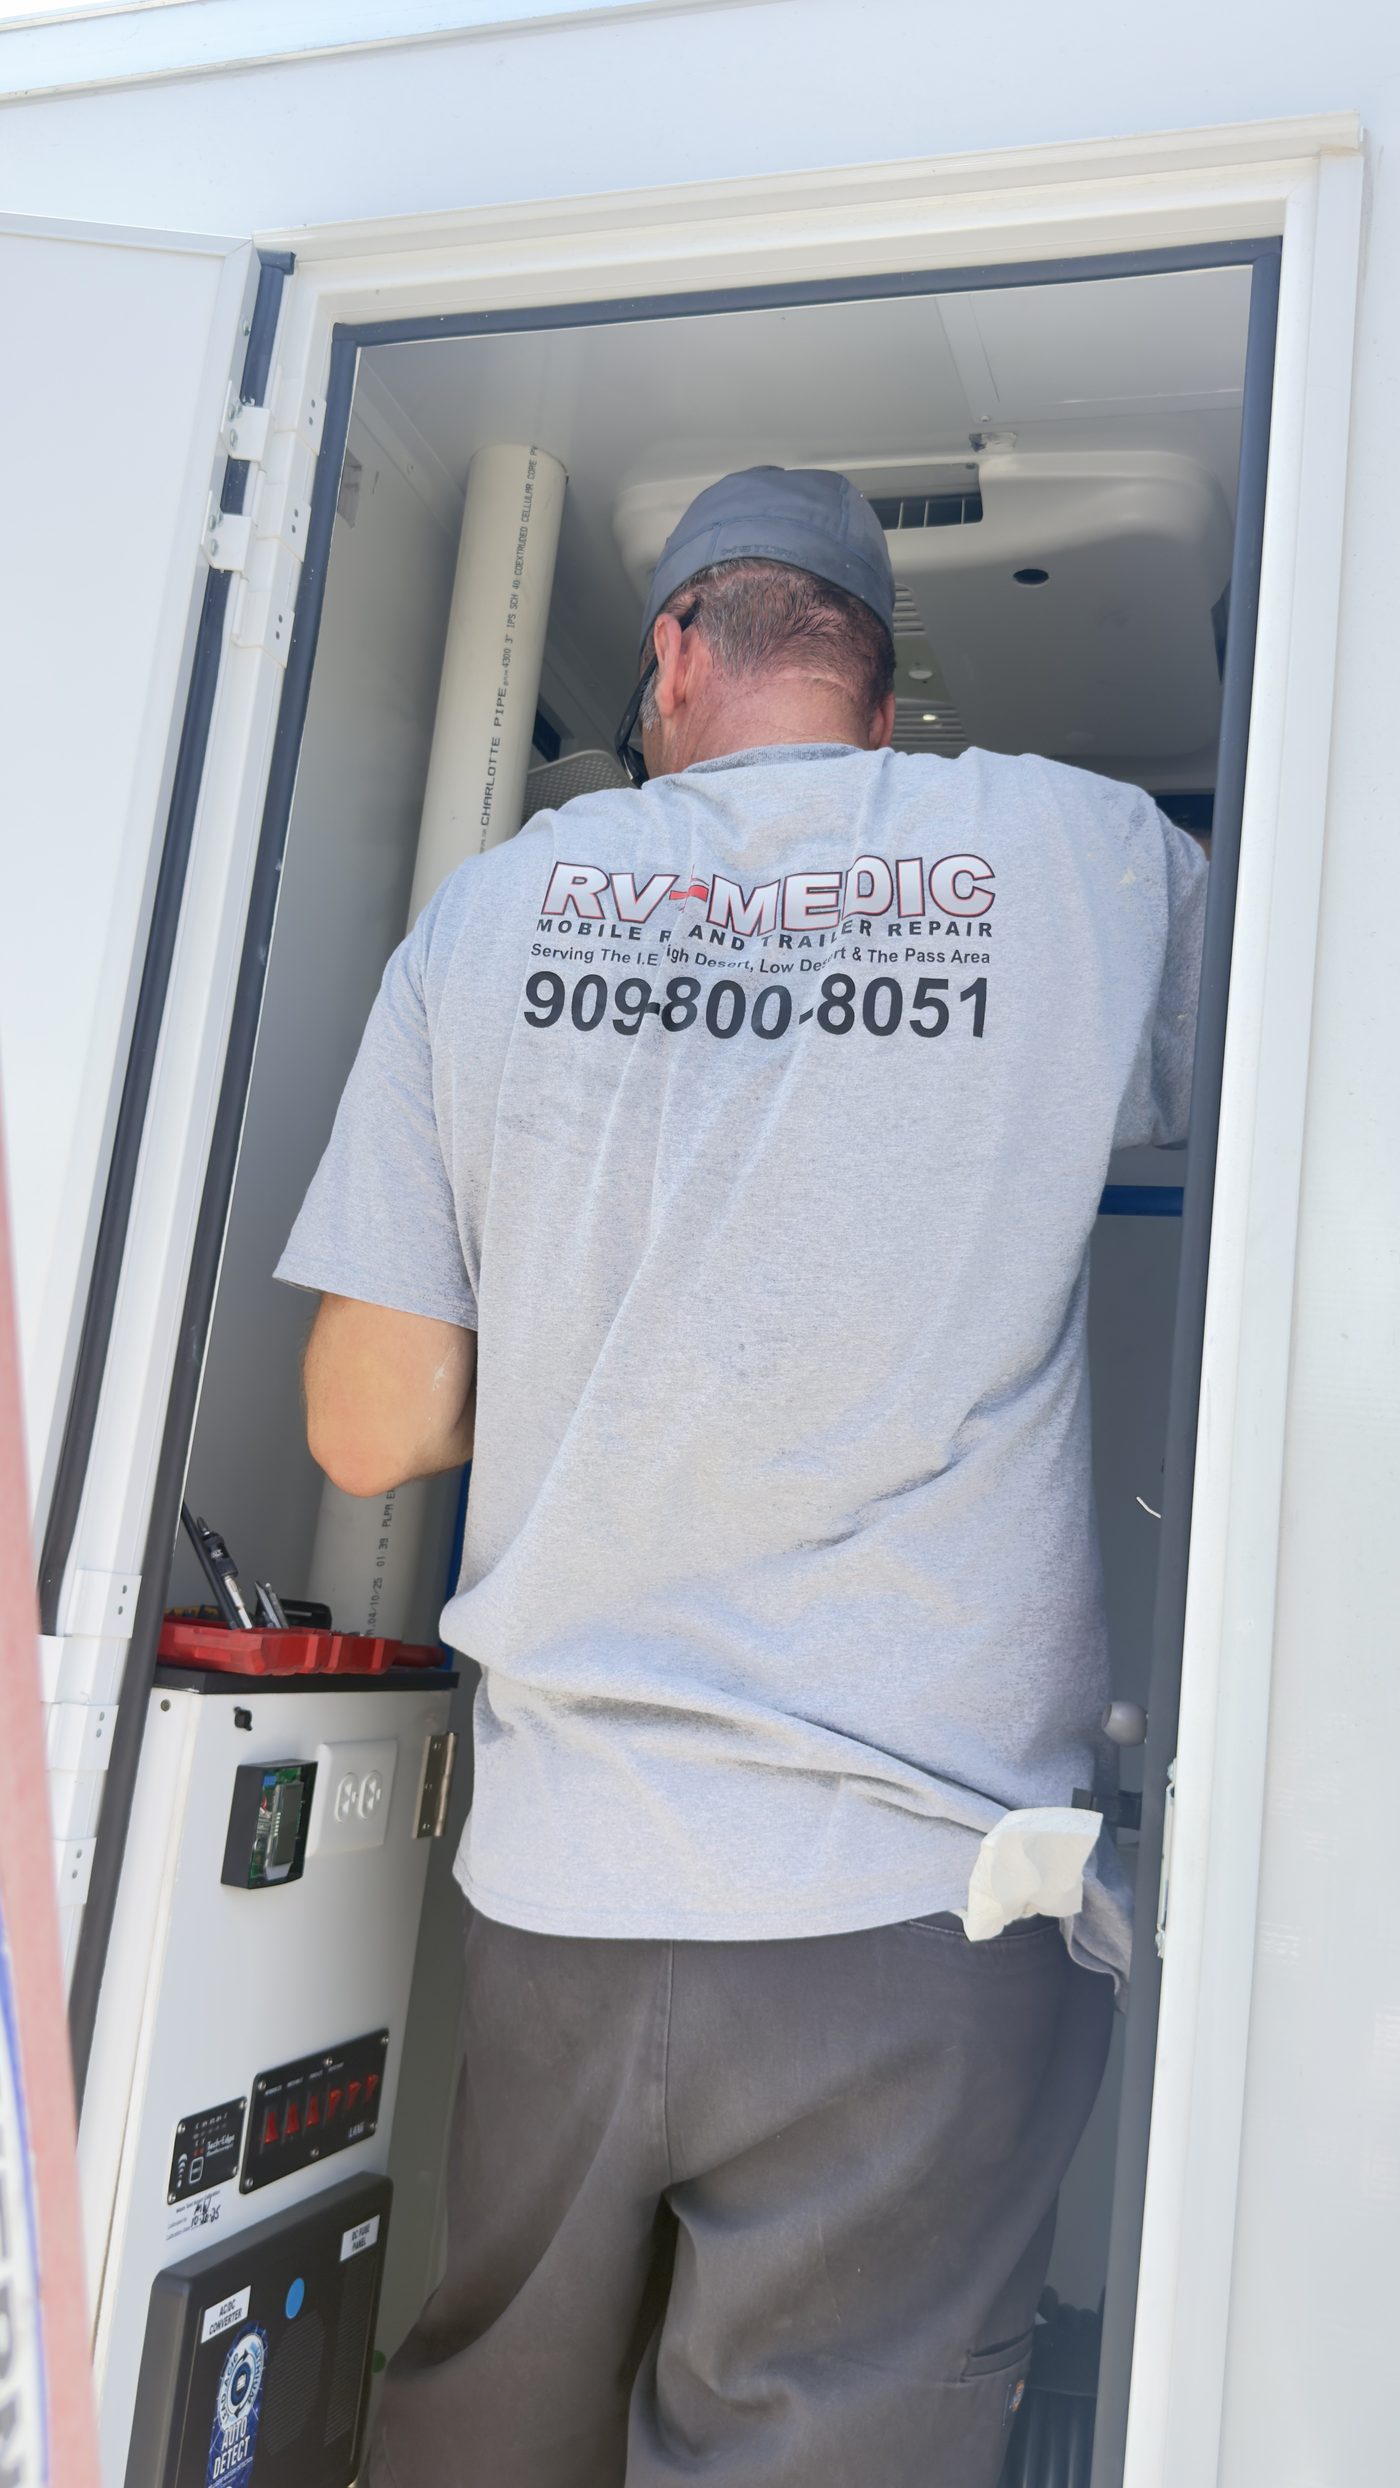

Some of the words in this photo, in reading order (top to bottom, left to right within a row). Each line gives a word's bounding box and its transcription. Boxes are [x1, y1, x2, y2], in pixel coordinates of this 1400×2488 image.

[526, 459, 537, 480] CORE
[520, 483, 534, 523] CELLULAR
[513, 525, 529, 576] COEXTRUDED
[509, 594, 519, 610] SCH
[511, 580, 521, 590] 40
[506, 613, 516, 628] IPS
[493, 687, 507, 727] PIPE
[480, 736, 501, 827] CHARLOTTE
[536, 919, 642, 941] MOBILE
[688, 924, 745, 951] AND
[761, 919, 872, 950] TRAILER
[888, 921, 992, 938] REPAIR
[531, 943, 594, 964] Serving
[600, 949, 631, 963] The
[666, 944, 689, 964] igh
[695, 952, 754, 973] Desert,
[759, 959, 794, 974] Low
[852, 946, 862, 961] &
[868, 949, 898, 963] The
[905, 948, 945, 963] Pass
[951, 949, 990, 963] Area
[523, 970, 988, 1040] 909-800-8051
[208, 2307, 243, 2336] CONVERTER
[221, 2416, 248, 2452] AUTO
[212, 2435, 251, 2480] DETECT
